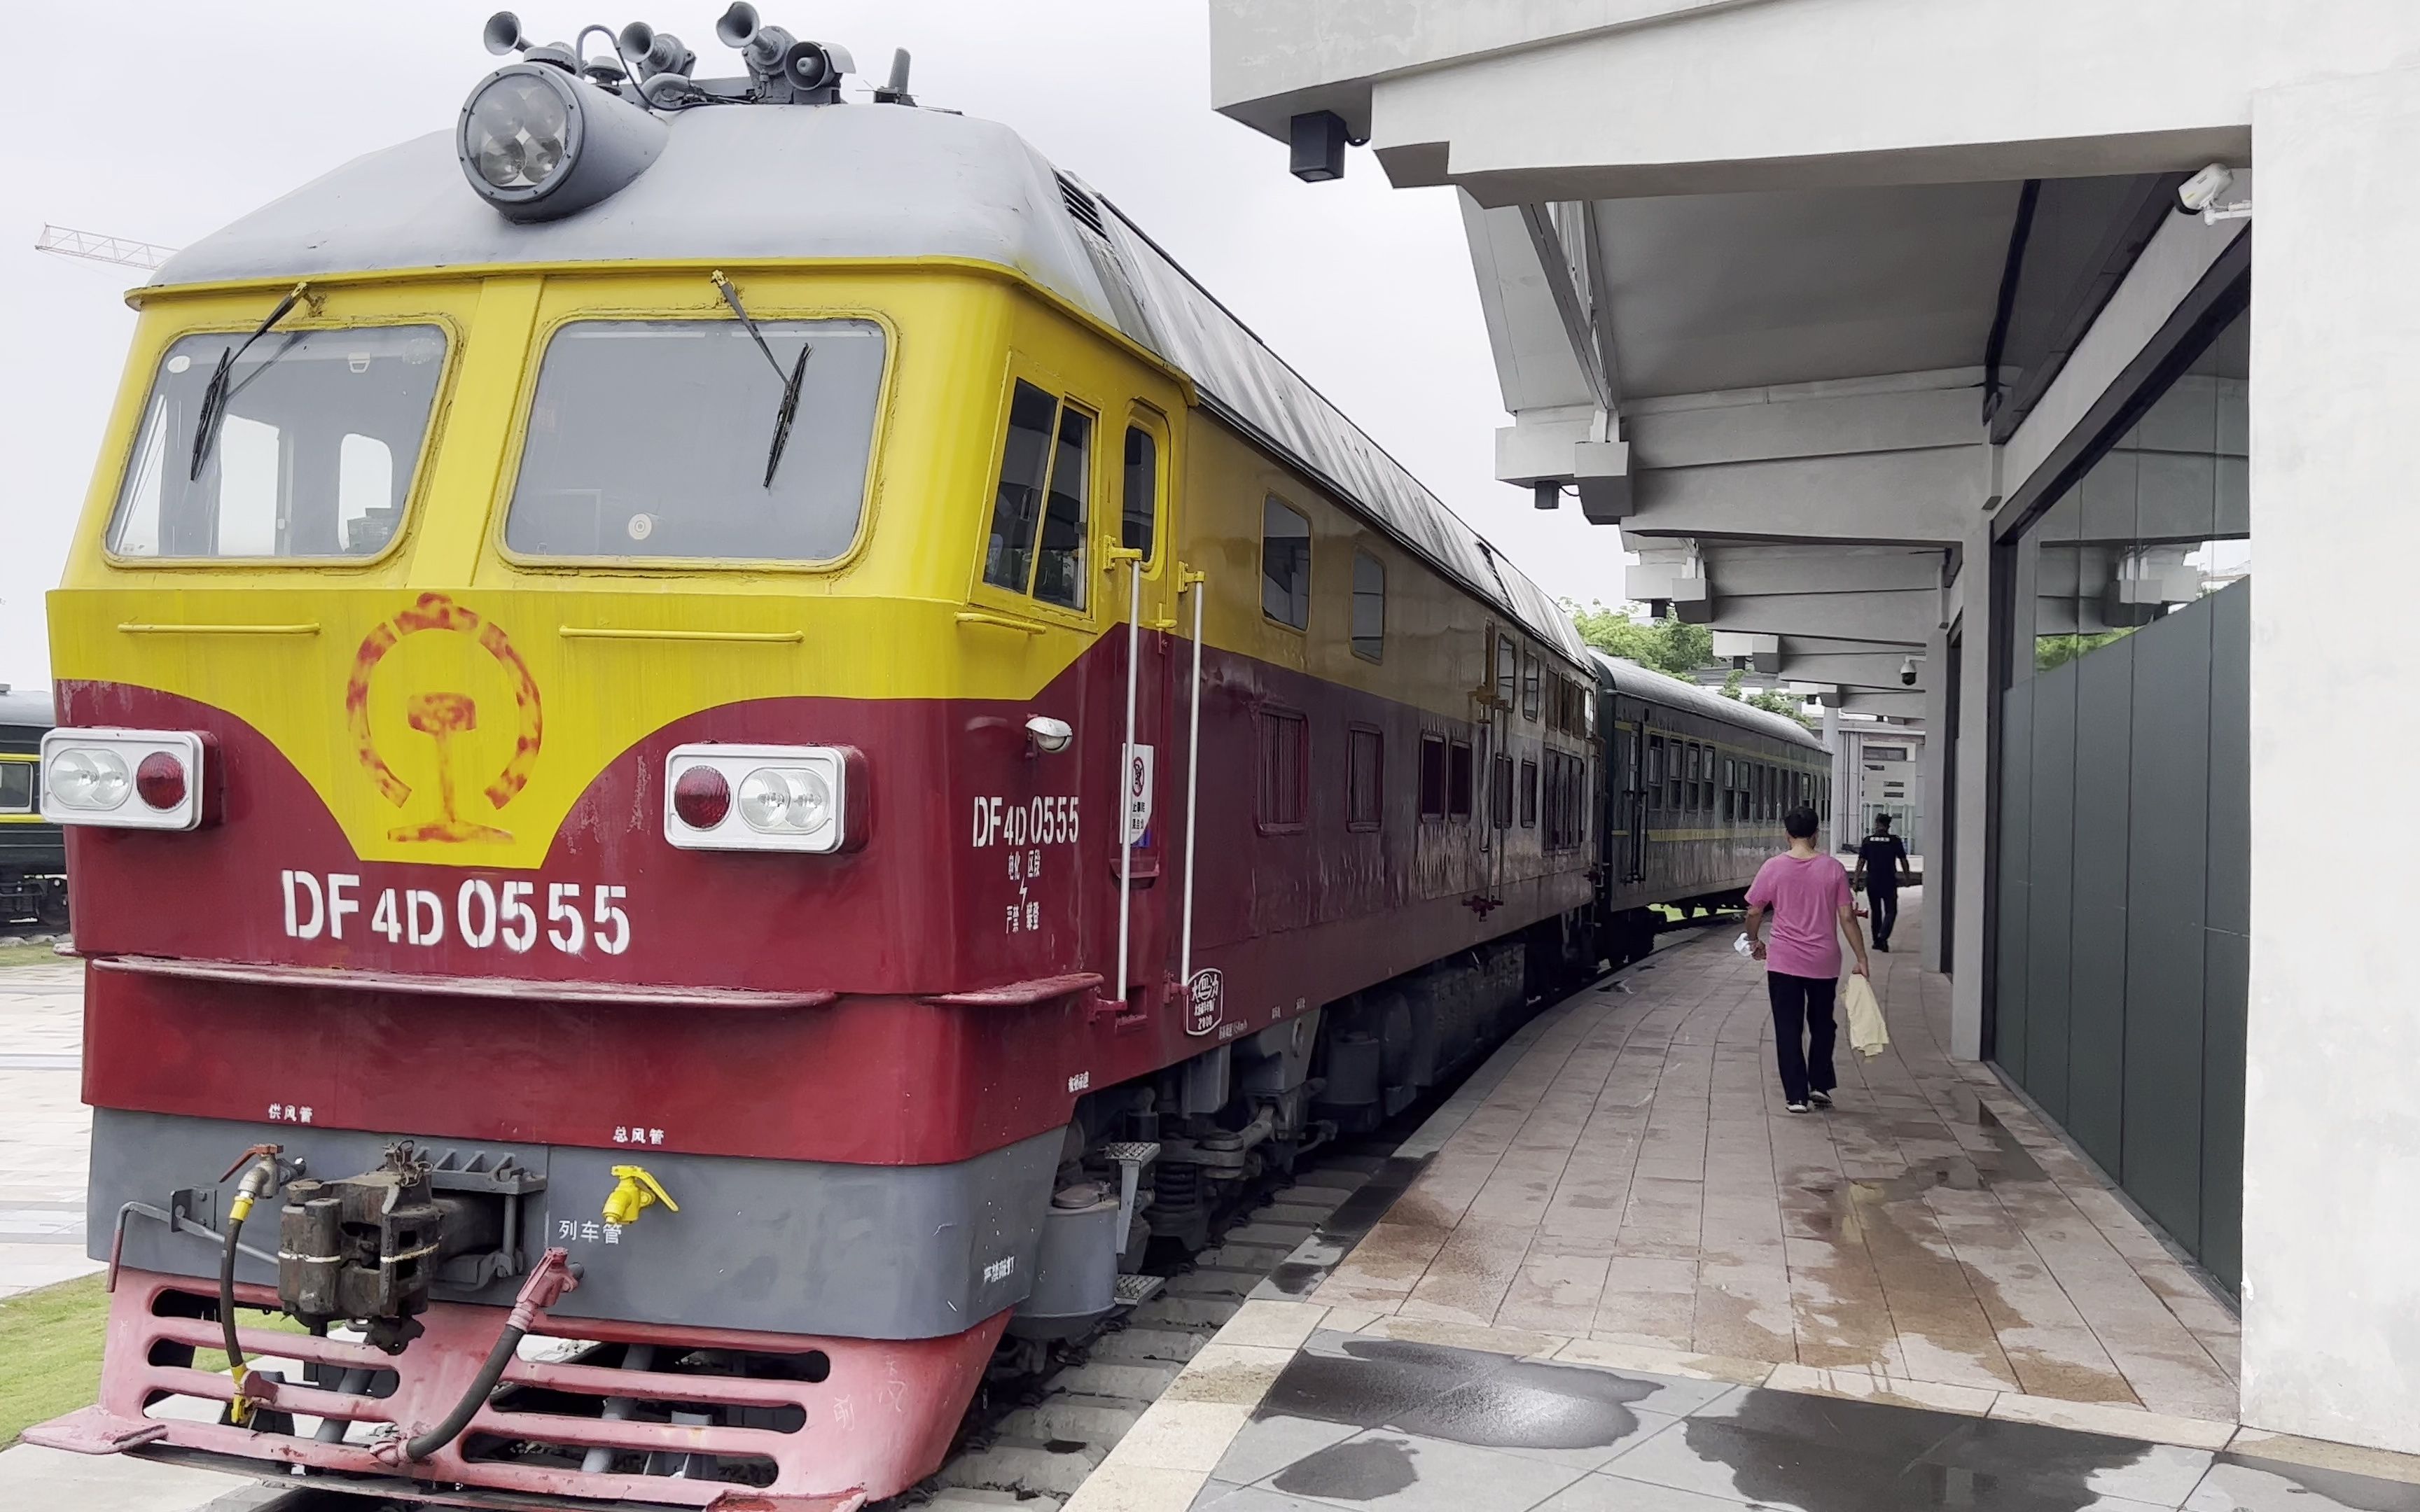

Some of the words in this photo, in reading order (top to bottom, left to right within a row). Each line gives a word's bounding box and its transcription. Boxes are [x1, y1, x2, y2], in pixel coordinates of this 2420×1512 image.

[268, 1103, 312, 1123] 供风管
[613, 1126, 665, 1144] 总风管
[559, 1220, 622, 1244] 列车管
